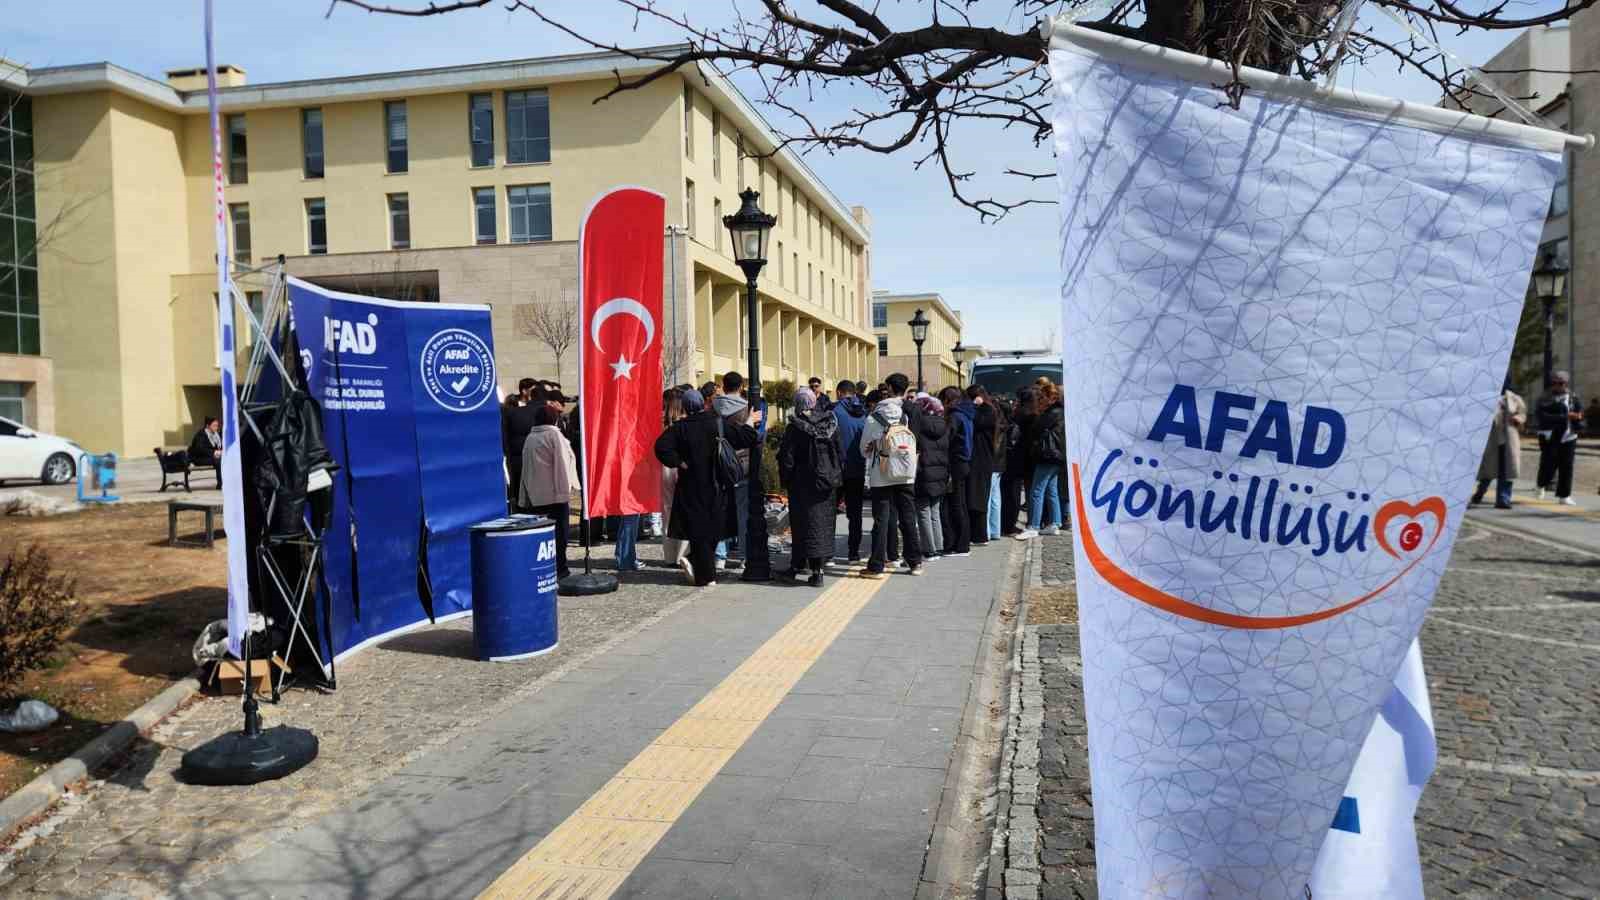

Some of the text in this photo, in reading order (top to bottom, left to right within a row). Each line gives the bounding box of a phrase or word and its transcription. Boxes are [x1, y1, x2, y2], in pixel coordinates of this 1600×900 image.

[432, 335, 453, 349] Durum
[454, 334, 483, 353] Yönetimi
[445, 349, 470, 360] AFAD
[440, 364, 479, 374] Akredite
[1147, 383, 1347, 469] AFAD
[1091, 448, 1371, 556] Gönüllüsü
